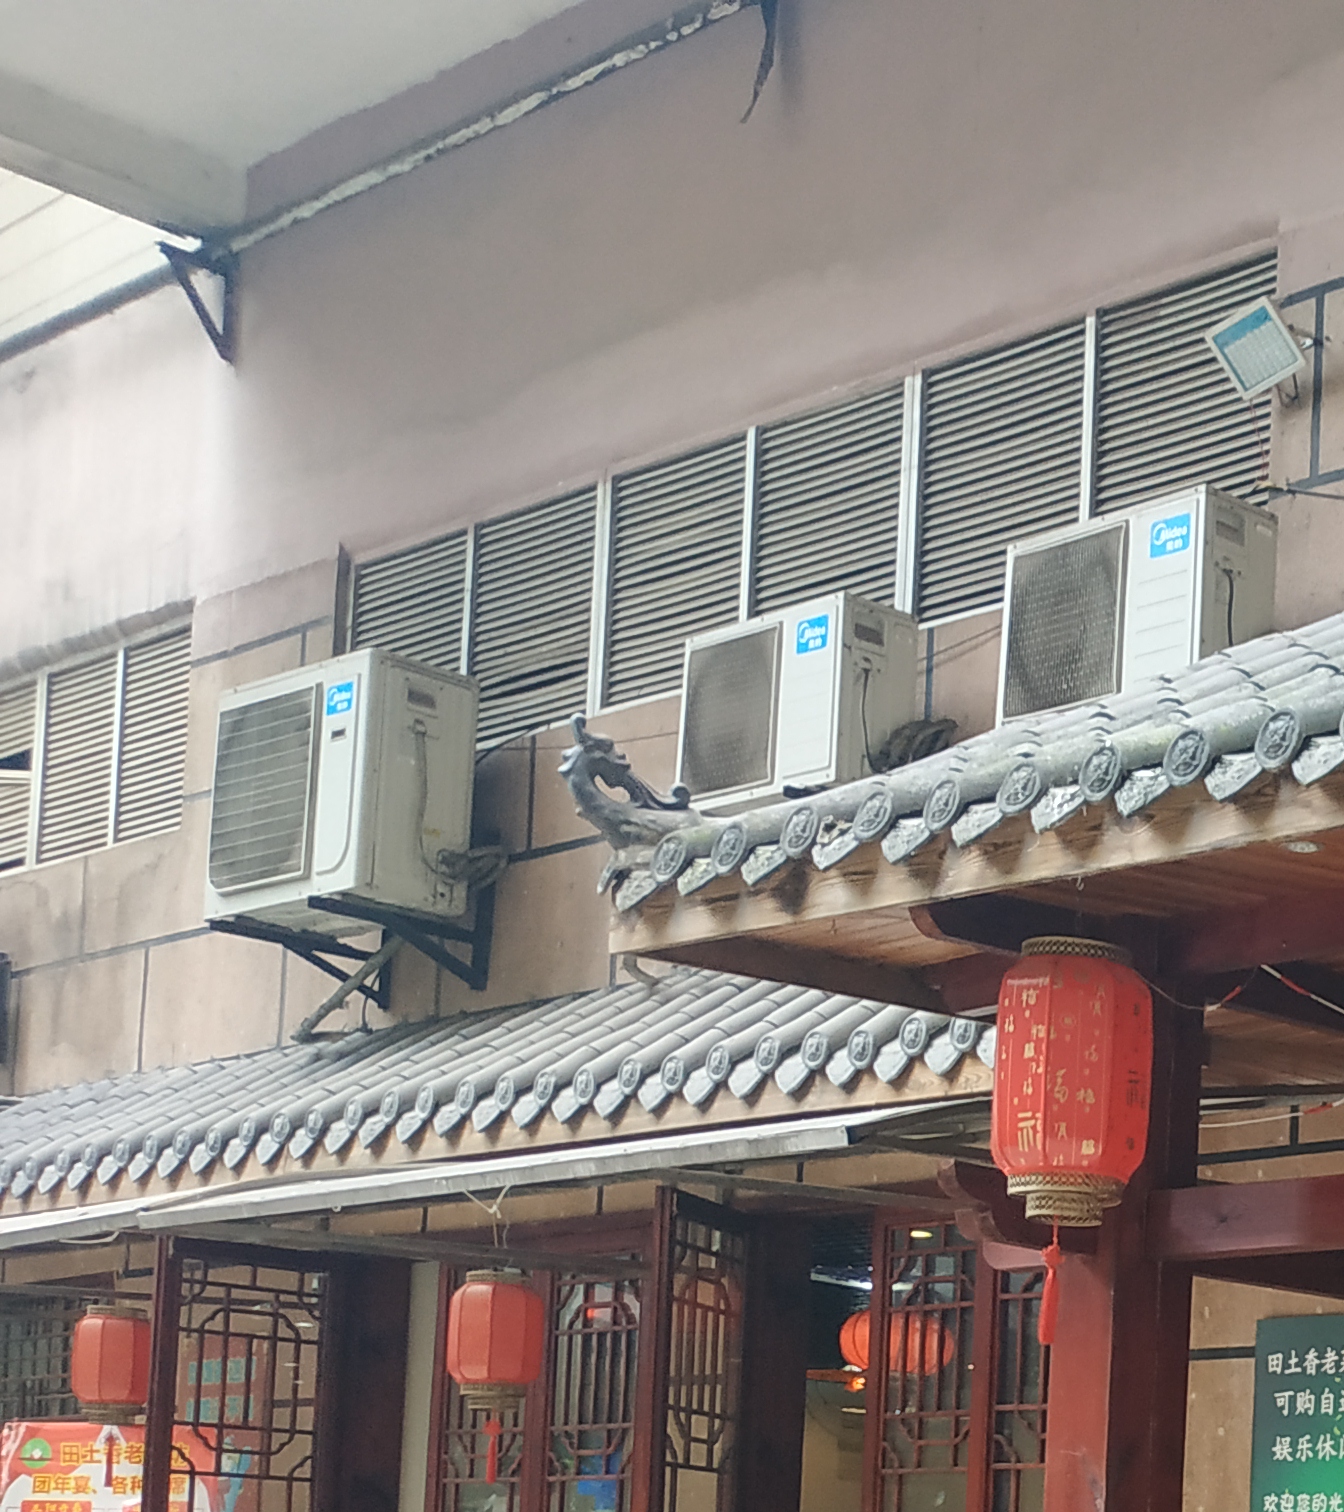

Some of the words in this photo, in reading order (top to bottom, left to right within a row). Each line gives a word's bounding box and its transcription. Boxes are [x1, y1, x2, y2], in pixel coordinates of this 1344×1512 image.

[60, 1442, 191, 1468] 田土香老坊
[31, 1473, 190, 1496] 团年宴、各种席
